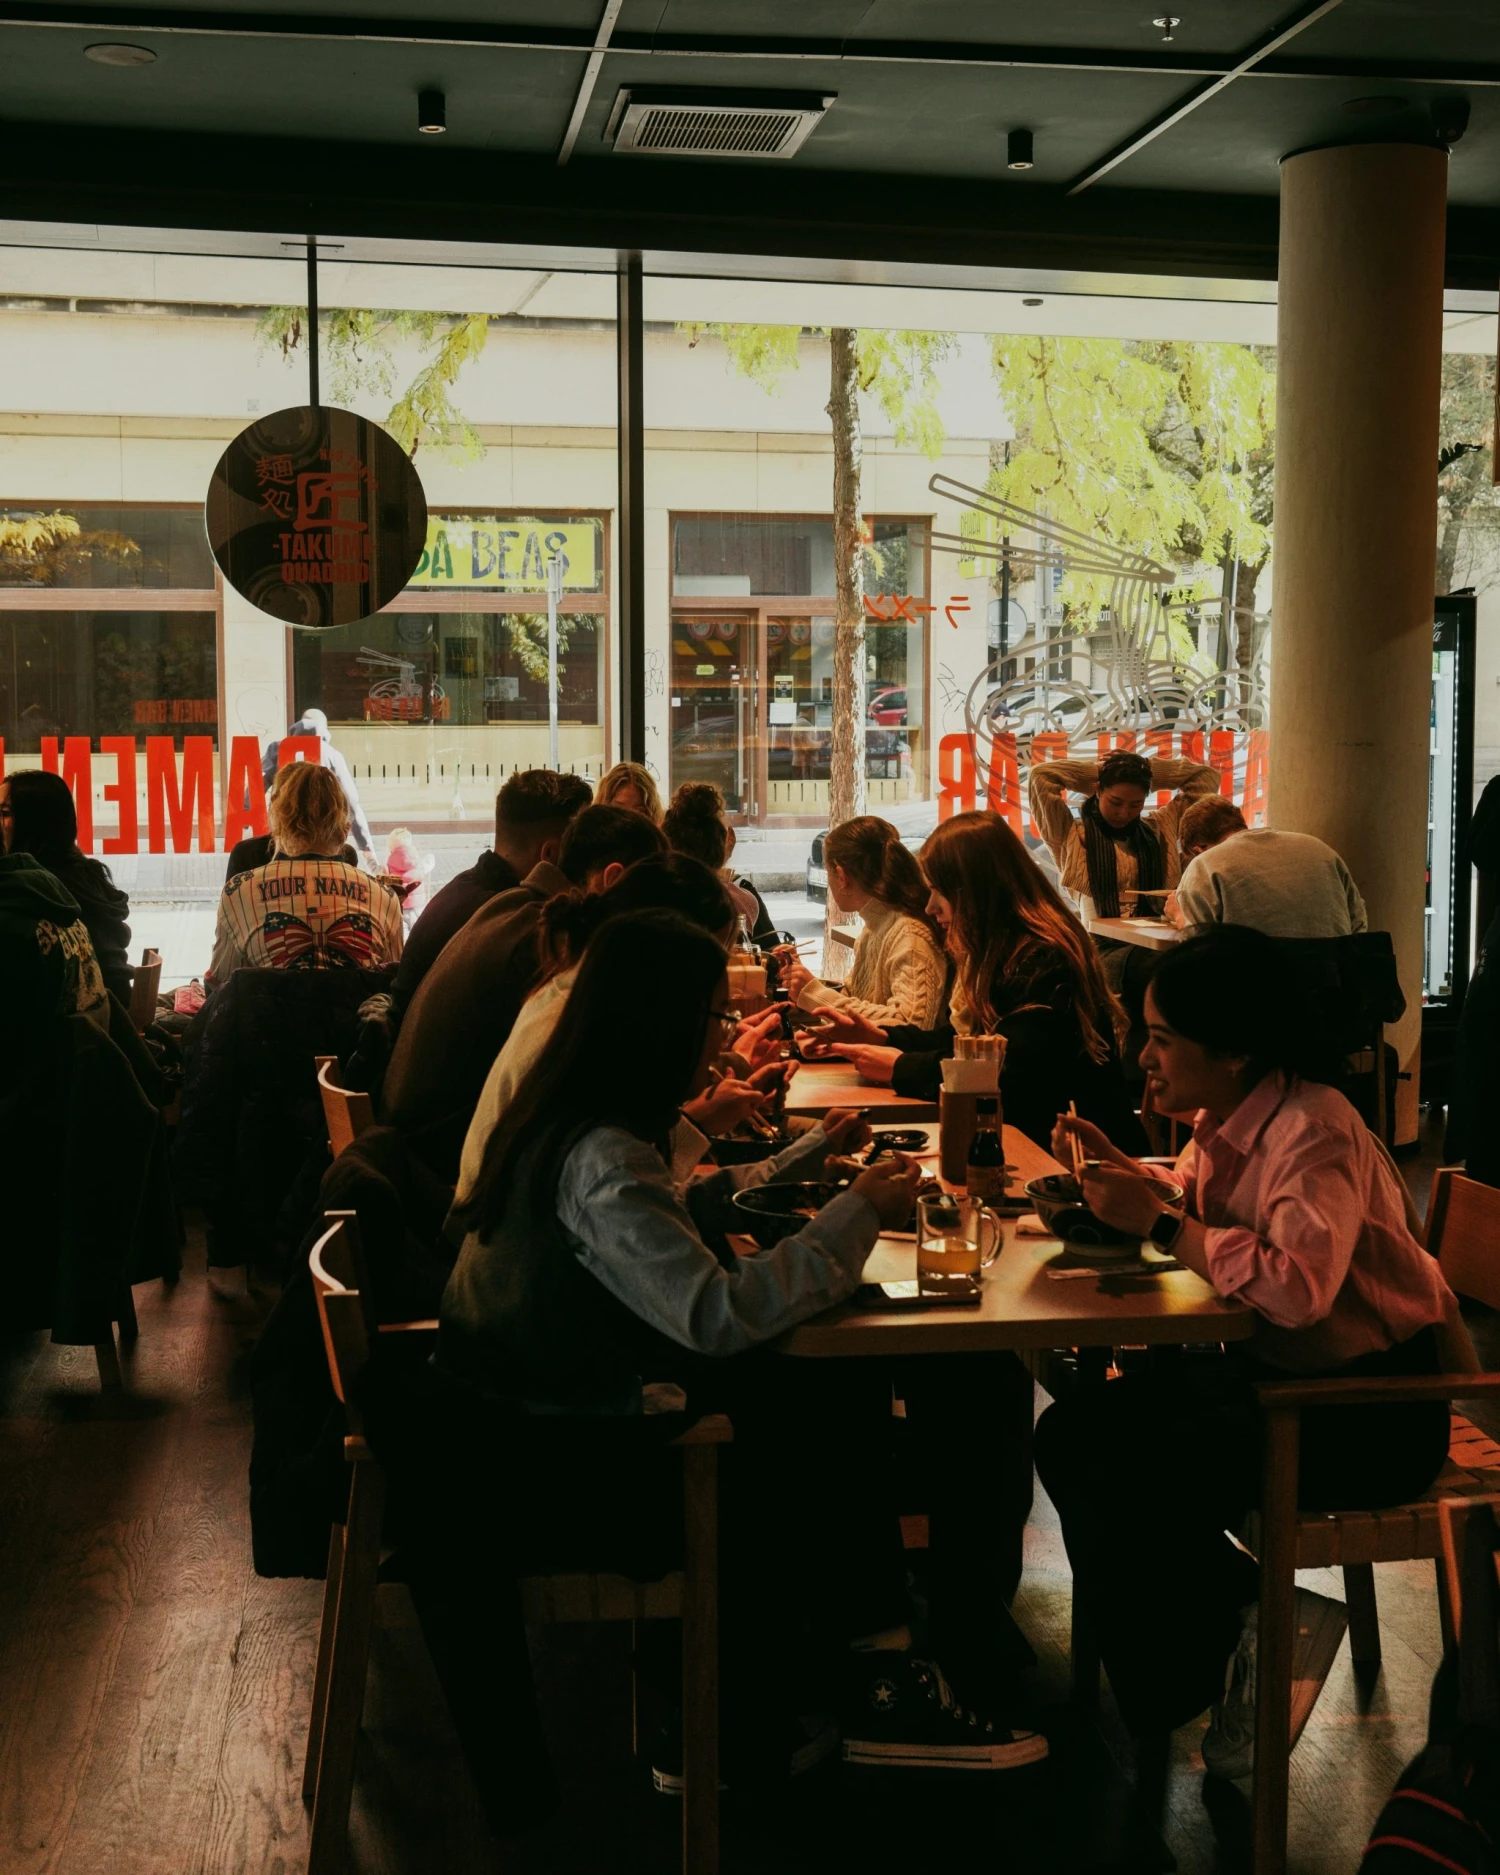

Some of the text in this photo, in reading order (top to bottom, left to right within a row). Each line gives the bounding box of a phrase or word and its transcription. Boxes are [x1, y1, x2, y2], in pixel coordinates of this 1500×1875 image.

[293, 472, 368, 531] 匠
[281, 562, 370, 584] QUADRIO
[472, 530, 570, 580] BEAS
[257, 876, 369, 904] YOUR NAME
